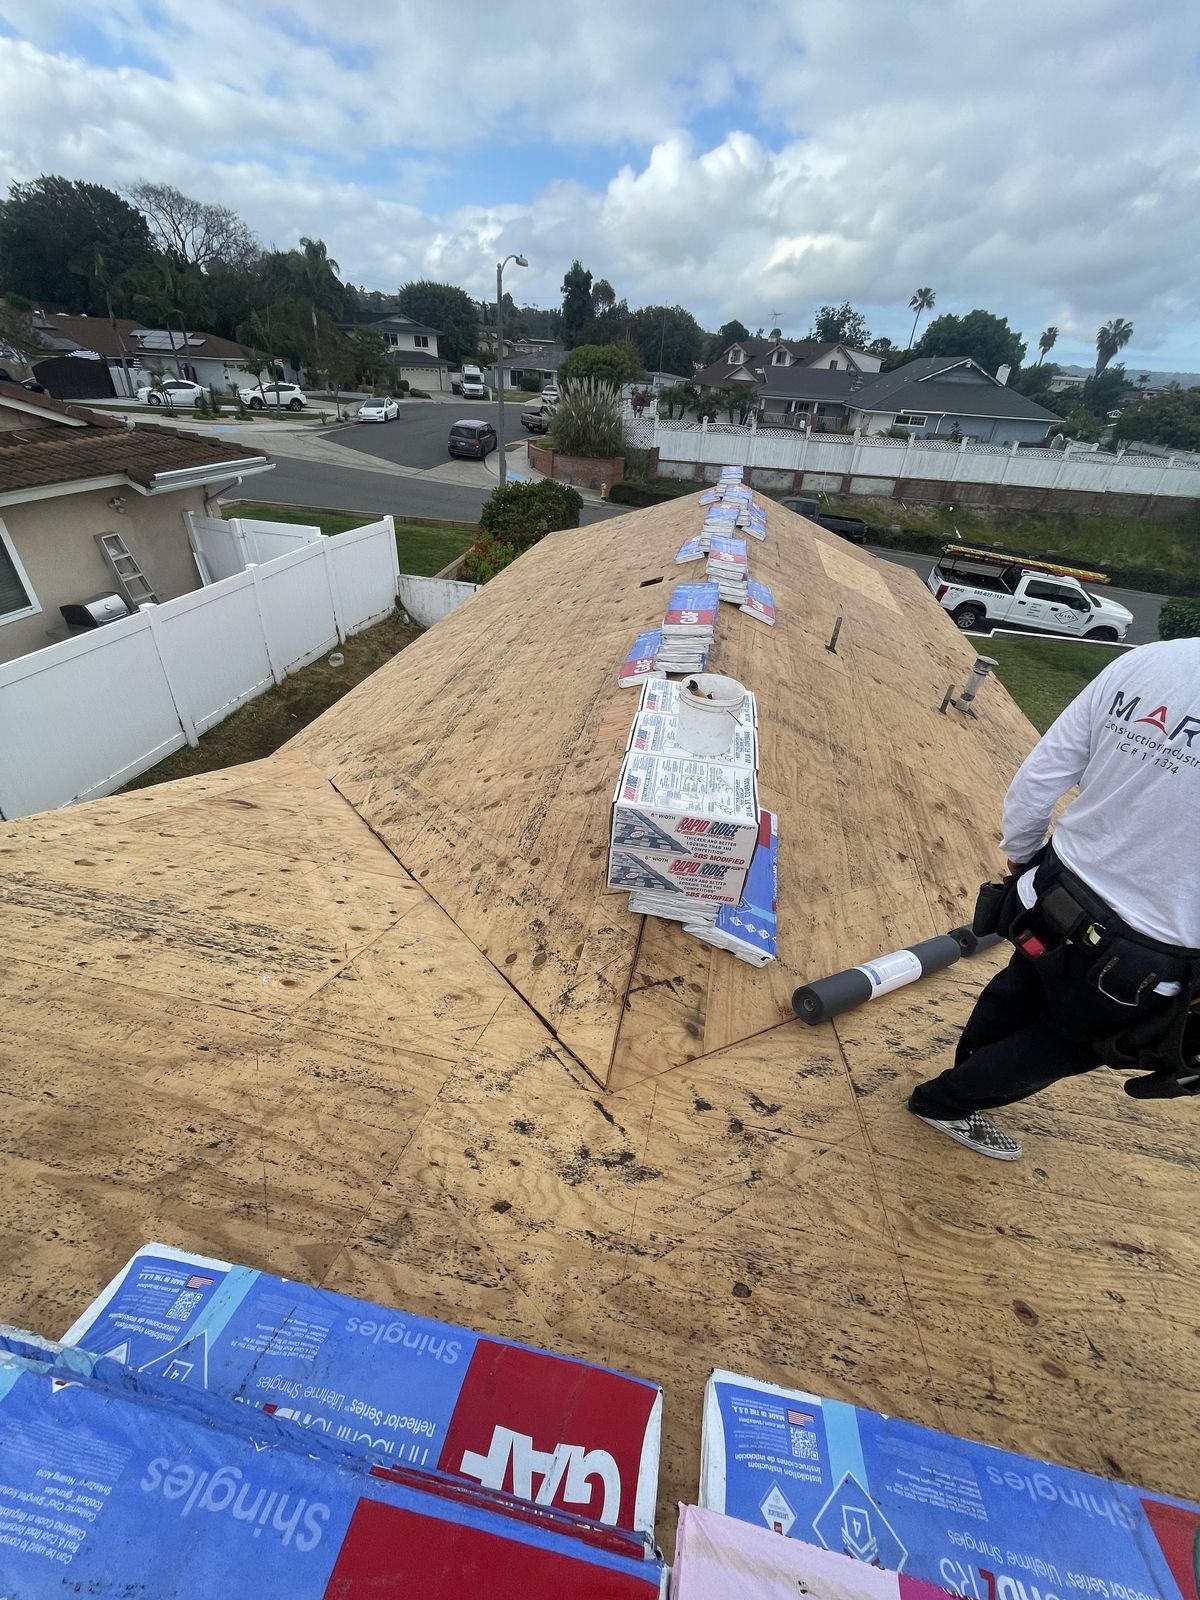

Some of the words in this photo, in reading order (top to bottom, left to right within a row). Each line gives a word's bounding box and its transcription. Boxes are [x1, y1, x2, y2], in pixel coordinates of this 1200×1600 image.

[678, 817, 711, 833] RAPID
[708, 821, 742, 837] RIDGE
[693, 852, 708, 860] SBS
[710, 855, 745, 865] MODIFIED
[670, 859, 701, 874] RAPID
[699, 863, 731, 878] RIDGE
[701, 894, 735, 903] MODIFIED
[170, 1277, 186, 1286] MADE
[344, 1316, 462, 1364] Shingles
[256, 1374, 302, 1399] Shingles
[749, 1408, 760, 1416] THE
[769, 1412, 785, 1422] MADE
[383, 1411, 436, 1438] Reflector
[766, 1455, 776, 1463] de
[777, 1457, 821, 1474] Instrucciones
[747, 1461, 783, 1476] instructions
[784, 1468, 822, 1486] Installation
[139, 1456, 331, 1552] Shingles
[985, 1465, 1137, 1532] Shingles
[852, 1517, 862, 1538] 4
[947, 1530, 1004, 1564] Shingles
[56, 1551, 73, 1565] Can
